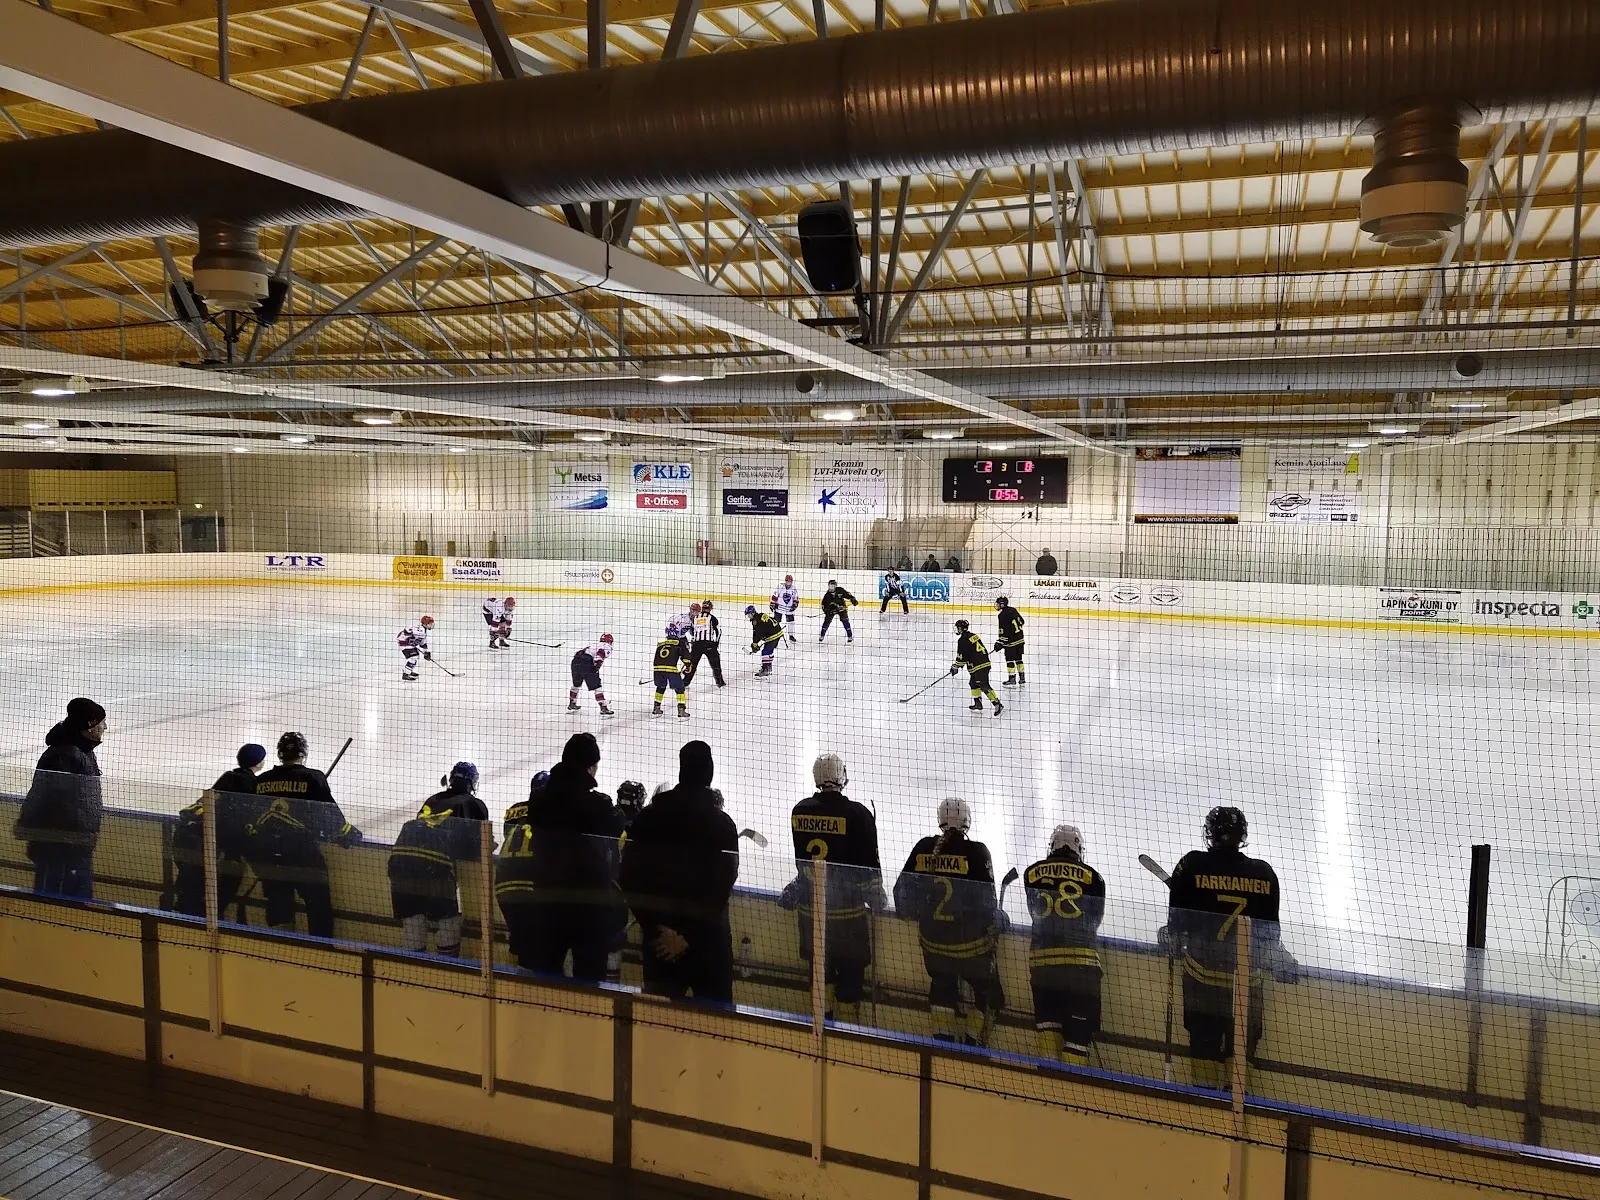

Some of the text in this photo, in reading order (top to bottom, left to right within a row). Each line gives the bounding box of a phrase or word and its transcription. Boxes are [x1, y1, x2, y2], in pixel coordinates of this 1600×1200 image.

[833, 459, 864, 468] Kemin
[1001, 462, 1008, 472] 3
[1275, 457, 1347, 469] Kemin Ajotilaus
[574, 472, 602, 482] Metsä
[653, 464, 691, 479] KLE
[813, 467, 885, 477] LVI-Palvelu Oy
[726, 495, 752, 503] Gerflor
[840, 498, 878, 506] ENERGIA
[265, 555, 325, 567] LTR
[452, 567, 501, 577] Esa&Pojat
[1381, 599, 1458, 611] LAPIN KUMI OY
[1475, 599, 1560, 618] Inspecta
[660, 645, 671, 658] 6
[975, 641, 987, 655] 4
[256, 780, 308, 793] KESKIKALLIO
[797, 817, 839, 832] KOSKELA
[924, 856, 960, 871] HIKKA
[1034, 864, 1084, 879] KOIVISTO
[1195, 874, 1271, 895] TARKIAINEN
[933, 876, 955, 921] 2
[1216, 894, 1248, 941] 7
